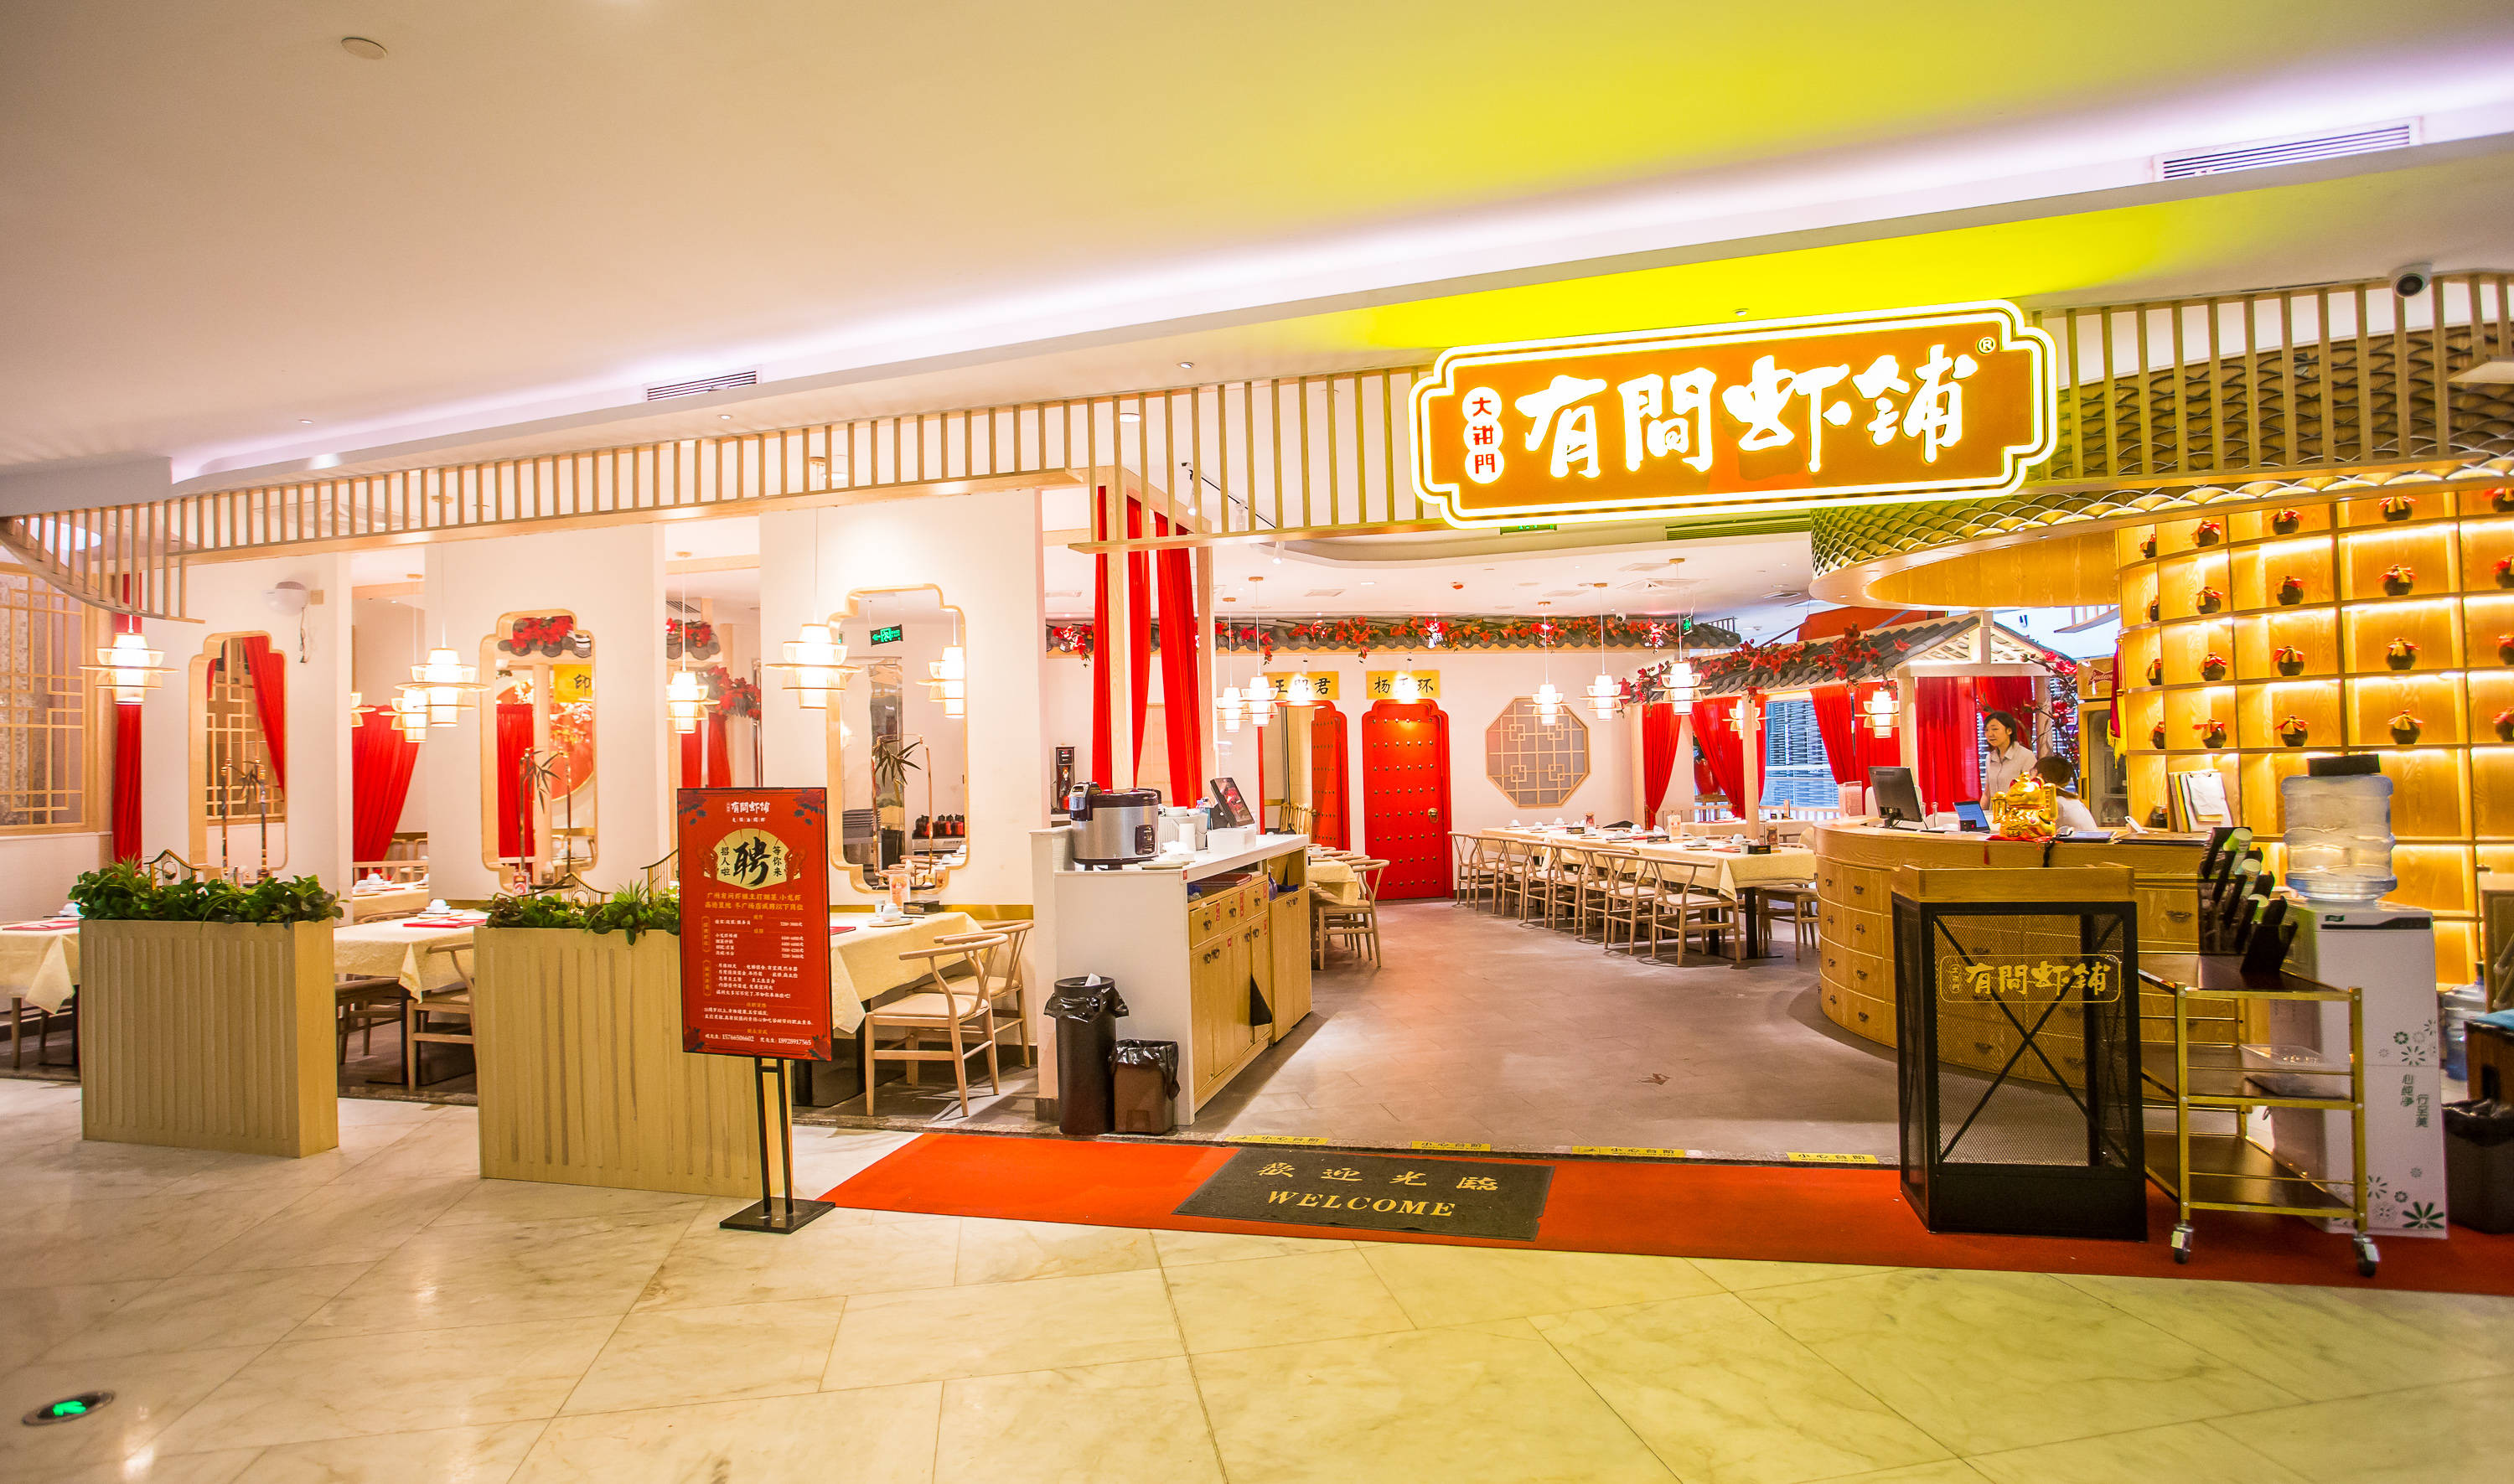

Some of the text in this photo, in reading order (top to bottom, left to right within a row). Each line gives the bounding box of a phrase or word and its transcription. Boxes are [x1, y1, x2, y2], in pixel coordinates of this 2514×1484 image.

[1373, 675, 1435, 694] 杨环
[721, 846, 731, 876] 招人啦
[733, 836, 772, 887] 聘
[772, 845, 783, 877] 等你来
[1267, 1190, 1456, 1217] WELCOME
